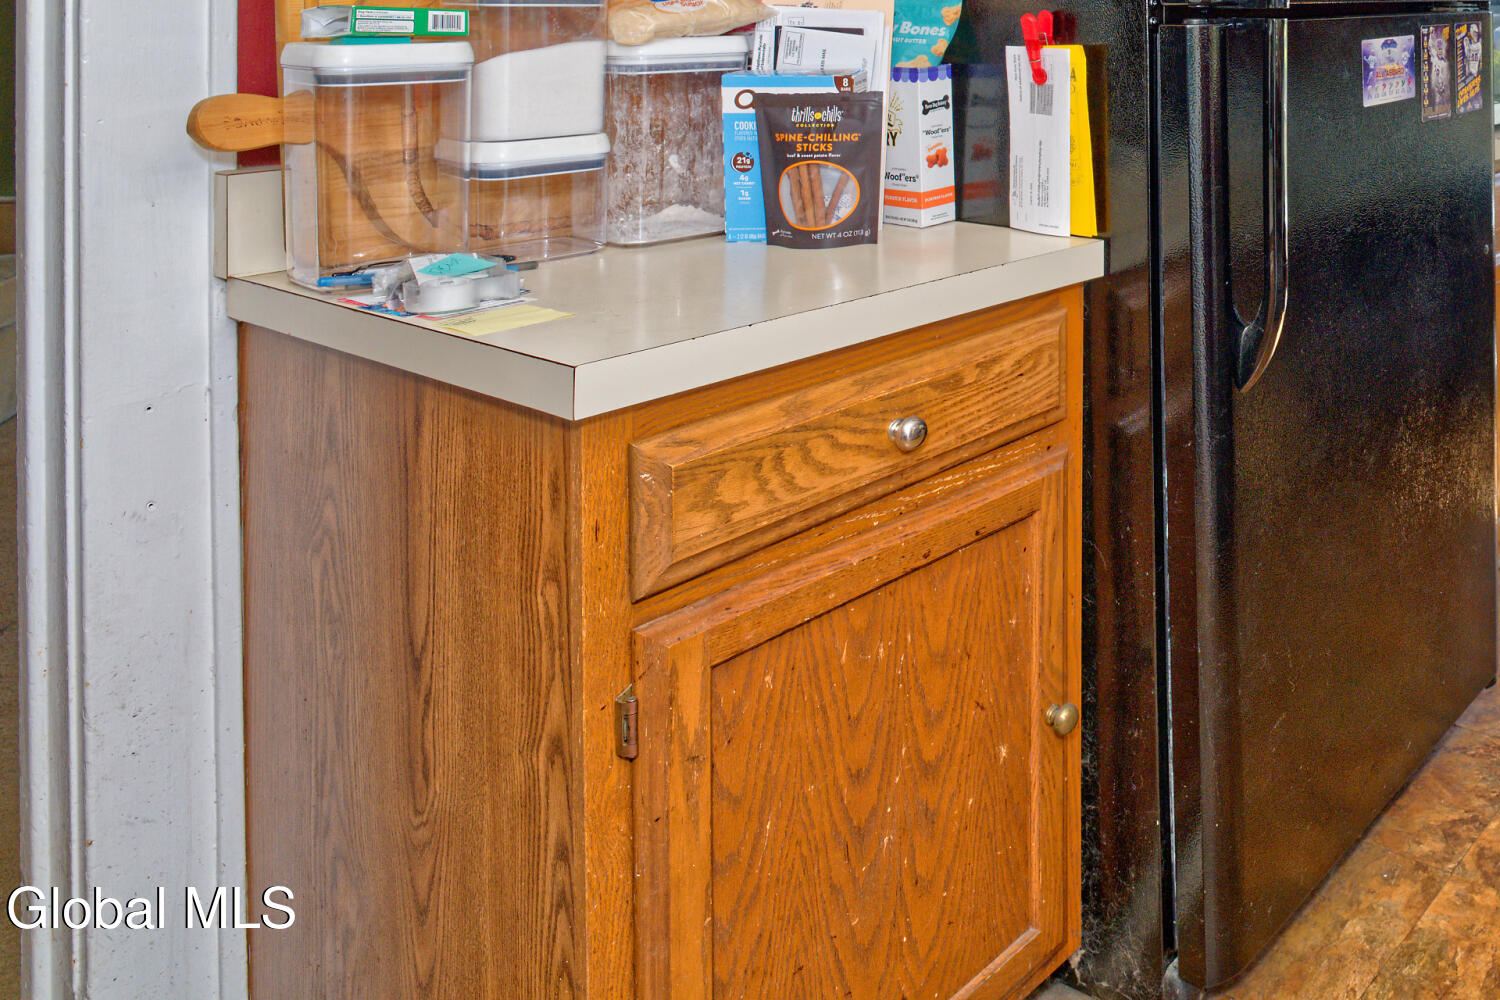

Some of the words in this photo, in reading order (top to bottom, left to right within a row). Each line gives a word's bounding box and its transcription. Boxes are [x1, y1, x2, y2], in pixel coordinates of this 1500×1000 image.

[900, 21, 946, 36] Bones
[843, 78, 848, 86] 8
[791, 106, 814, 122] thrills
[822, 105, 842, 122] chills
[734, 121, 757, 131] COOKI
[775, 133, 859, 143] SPINE-CHILLING
[796, 143, 833, 152] STICKS
[737, 157, 751, 165] 21g
[812, 232, 825, 240] NET
[826, 232, 836, 240] WT
